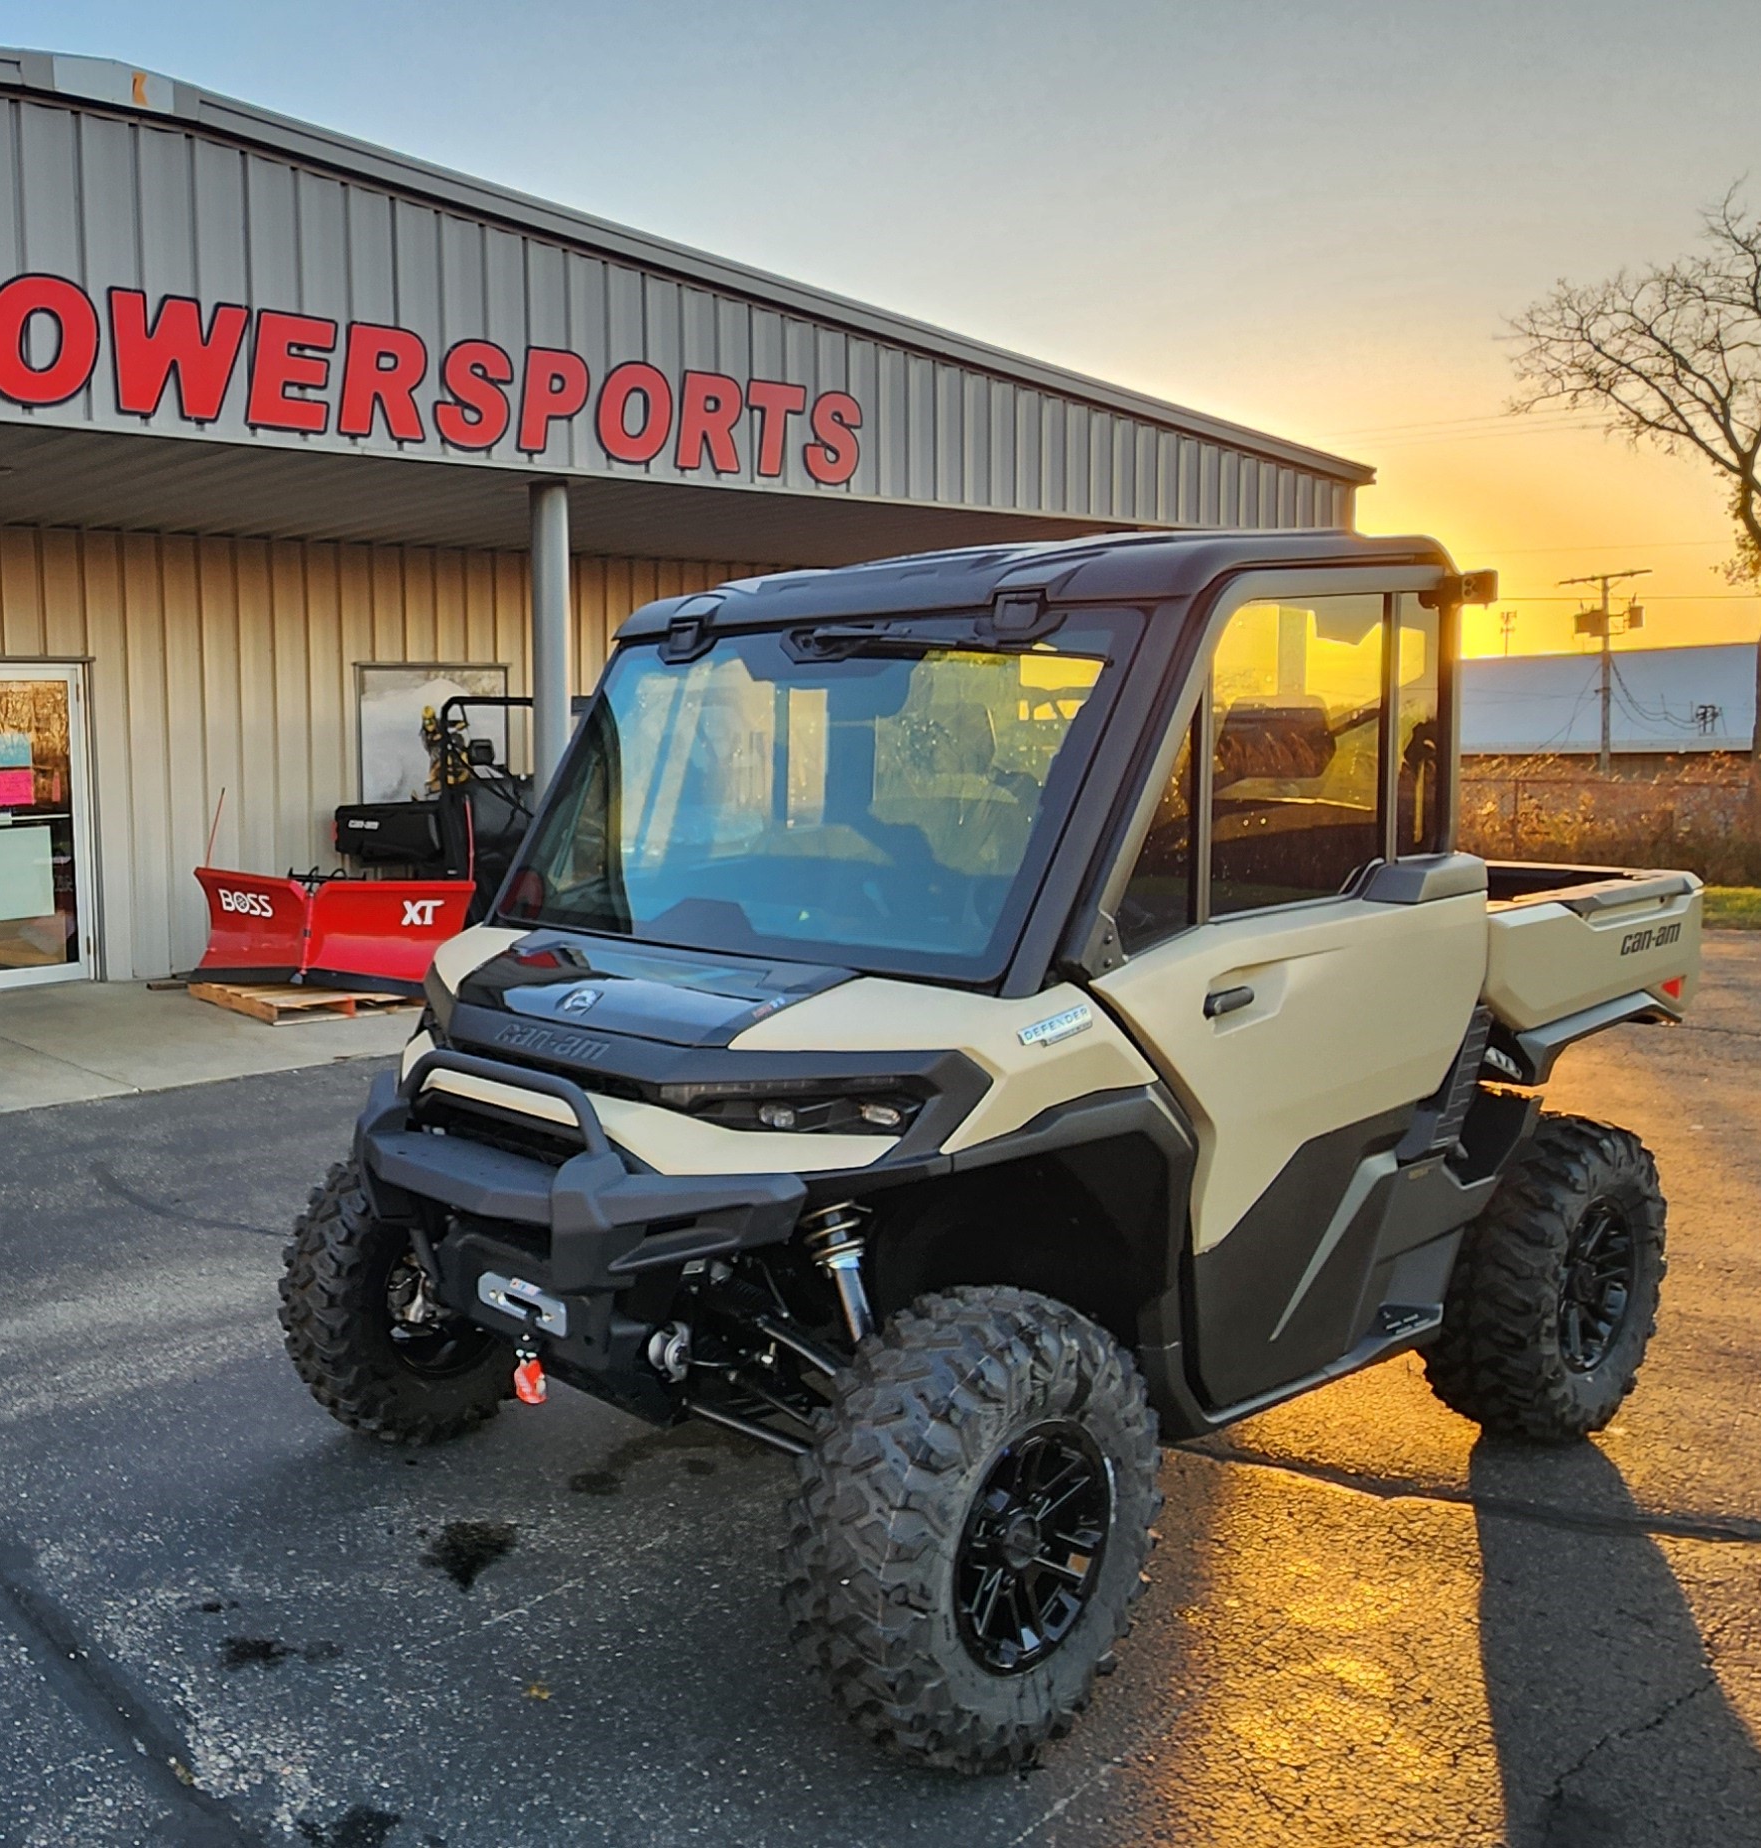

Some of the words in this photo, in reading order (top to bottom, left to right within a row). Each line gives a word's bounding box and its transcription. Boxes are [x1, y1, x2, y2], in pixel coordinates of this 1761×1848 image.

[218, 888, 273, 918] BOSS
[401, 900, 445, 926] XT
[1620, 922, 1682, 957] can-am
[1023, 1007, 1088, 1041] DEFENDER
